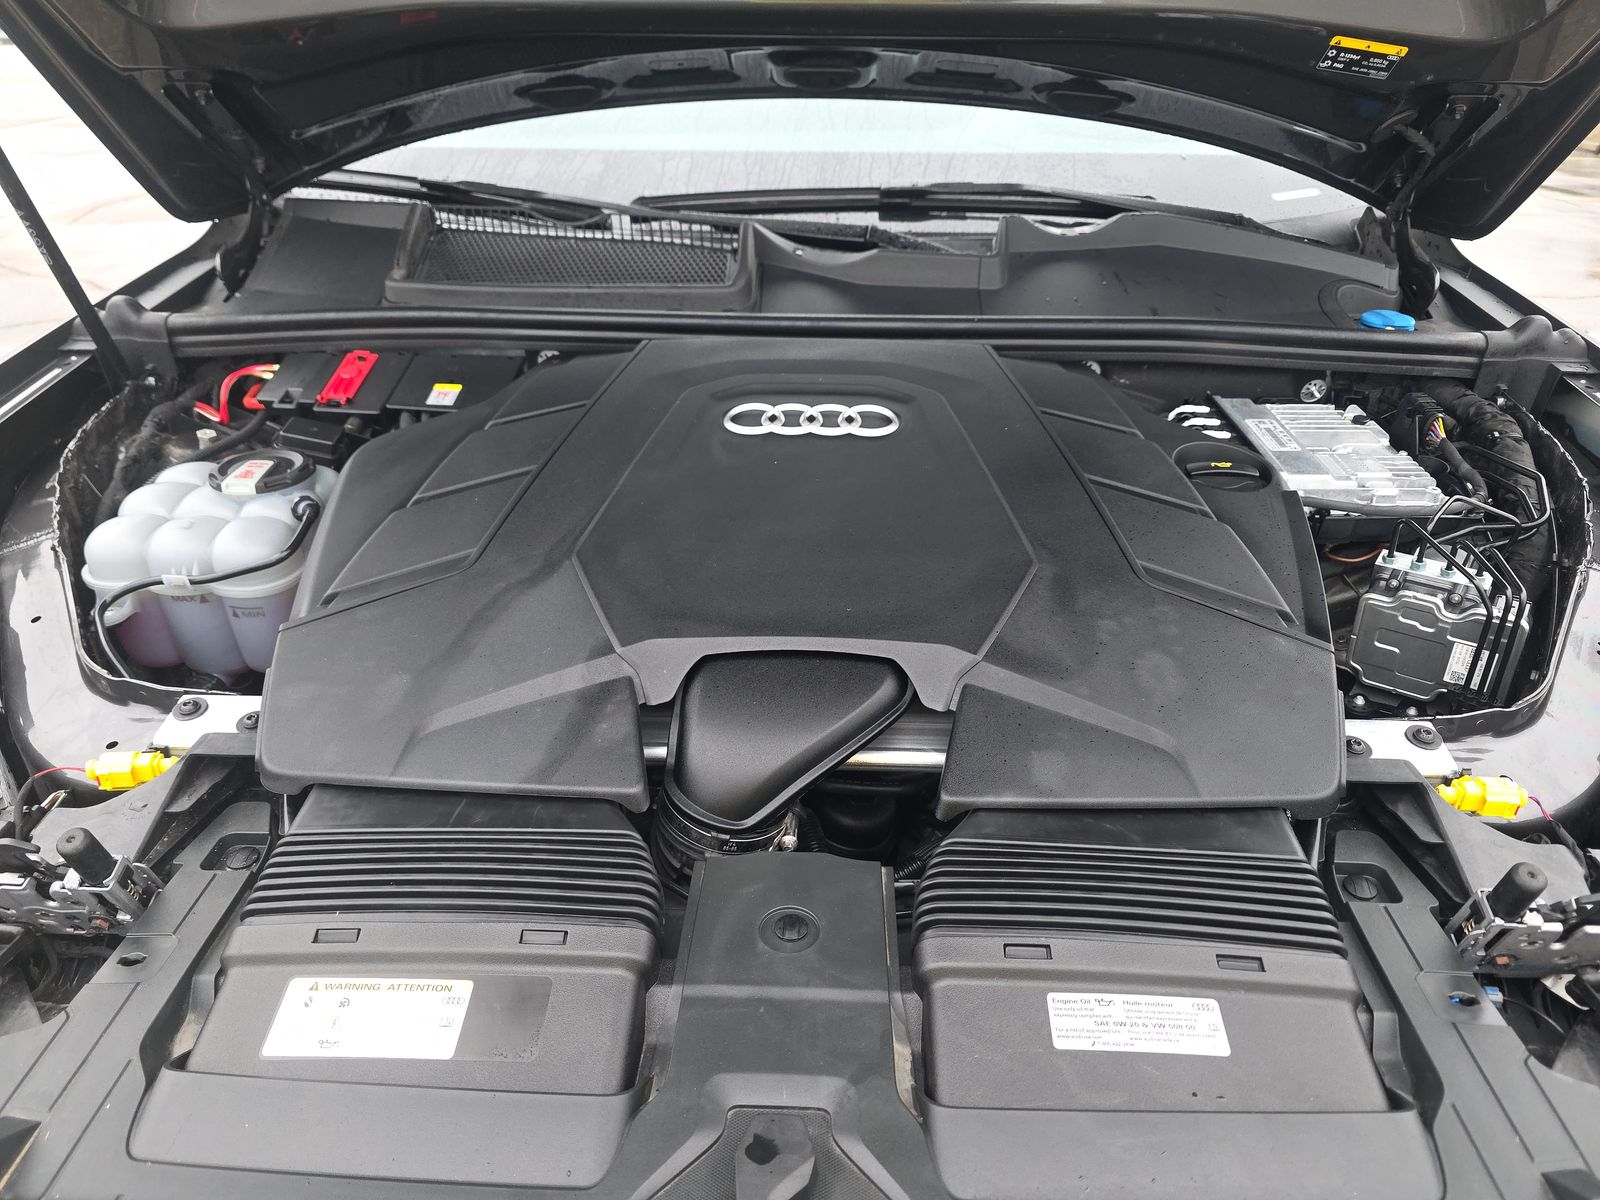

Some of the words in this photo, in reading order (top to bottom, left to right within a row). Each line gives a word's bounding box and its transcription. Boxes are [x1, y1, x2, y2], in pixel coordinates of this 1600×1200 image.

[324, 983, 381, 991] WARNING
[386, 983, 453, 992] ATTENTION
[1052, 997, 1078, 1005] Engine
[1122, 999, 1143, 1007] Huile
